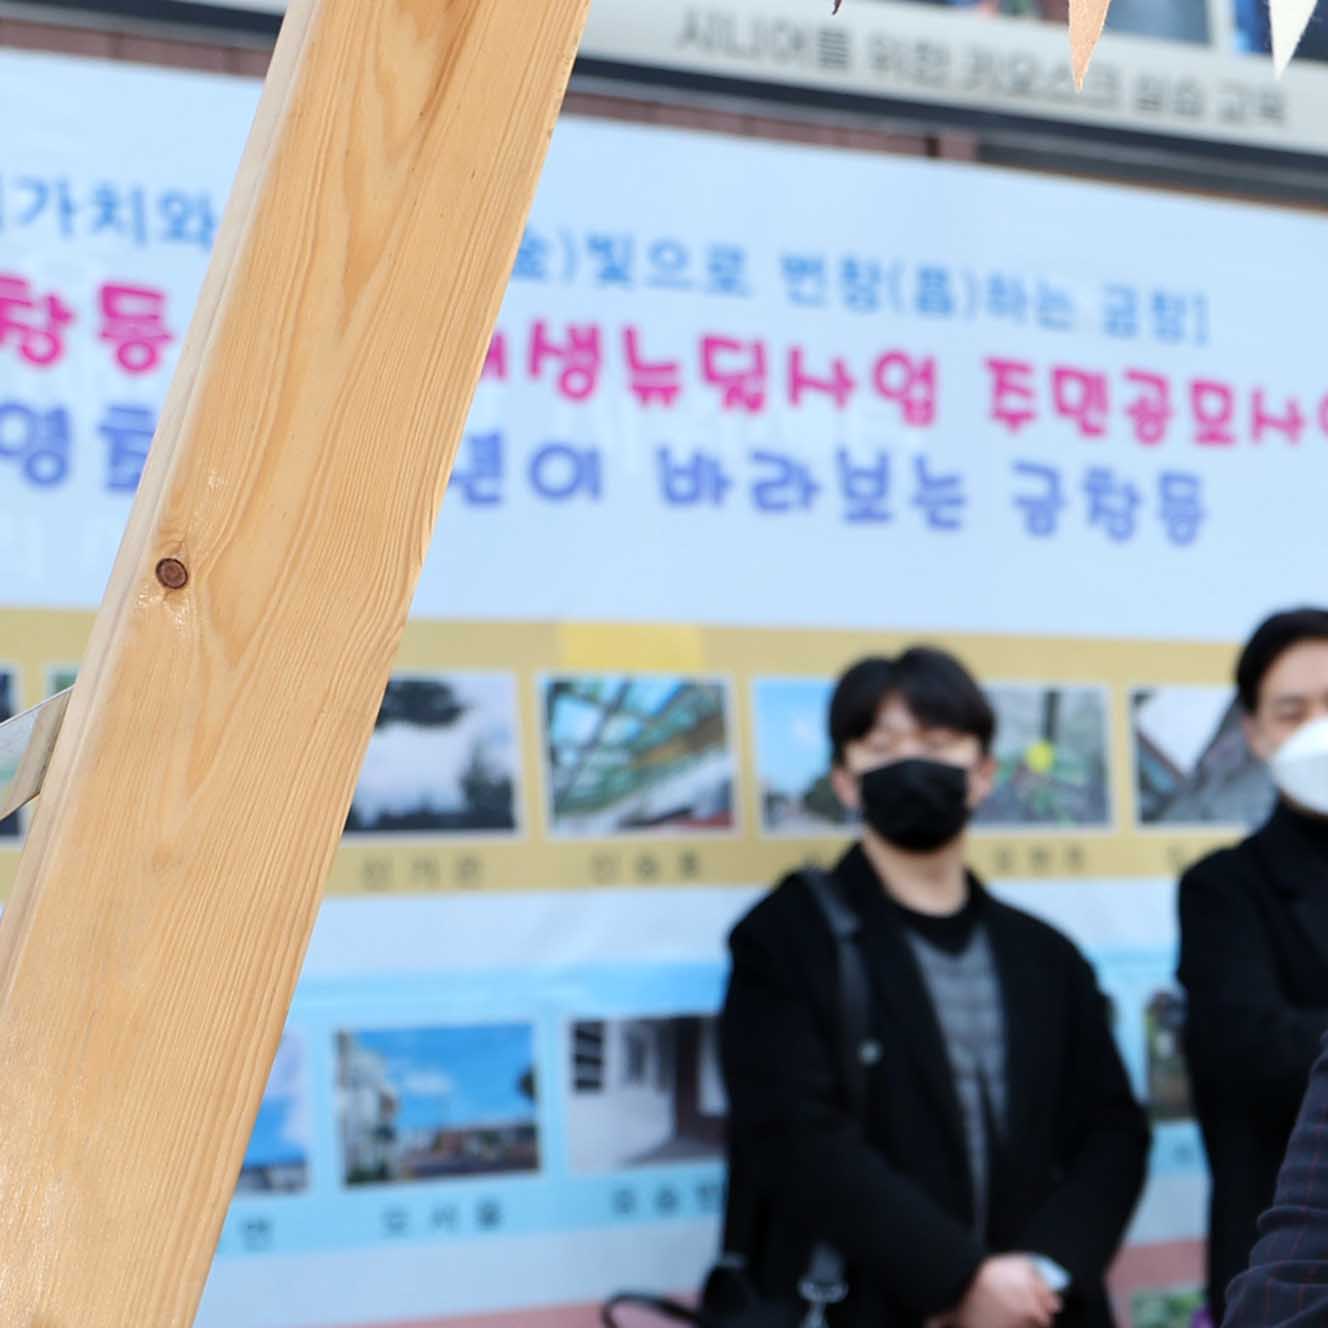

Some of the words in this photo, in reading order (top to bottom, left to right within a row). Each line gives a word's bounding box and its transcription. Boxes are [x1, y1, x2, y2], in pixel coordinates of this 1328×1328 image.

[0, 178, 214, 250] 가치와
[656, 448, 967, 530] 바라보는
[1010, 460, 1205, 546] 금창동
